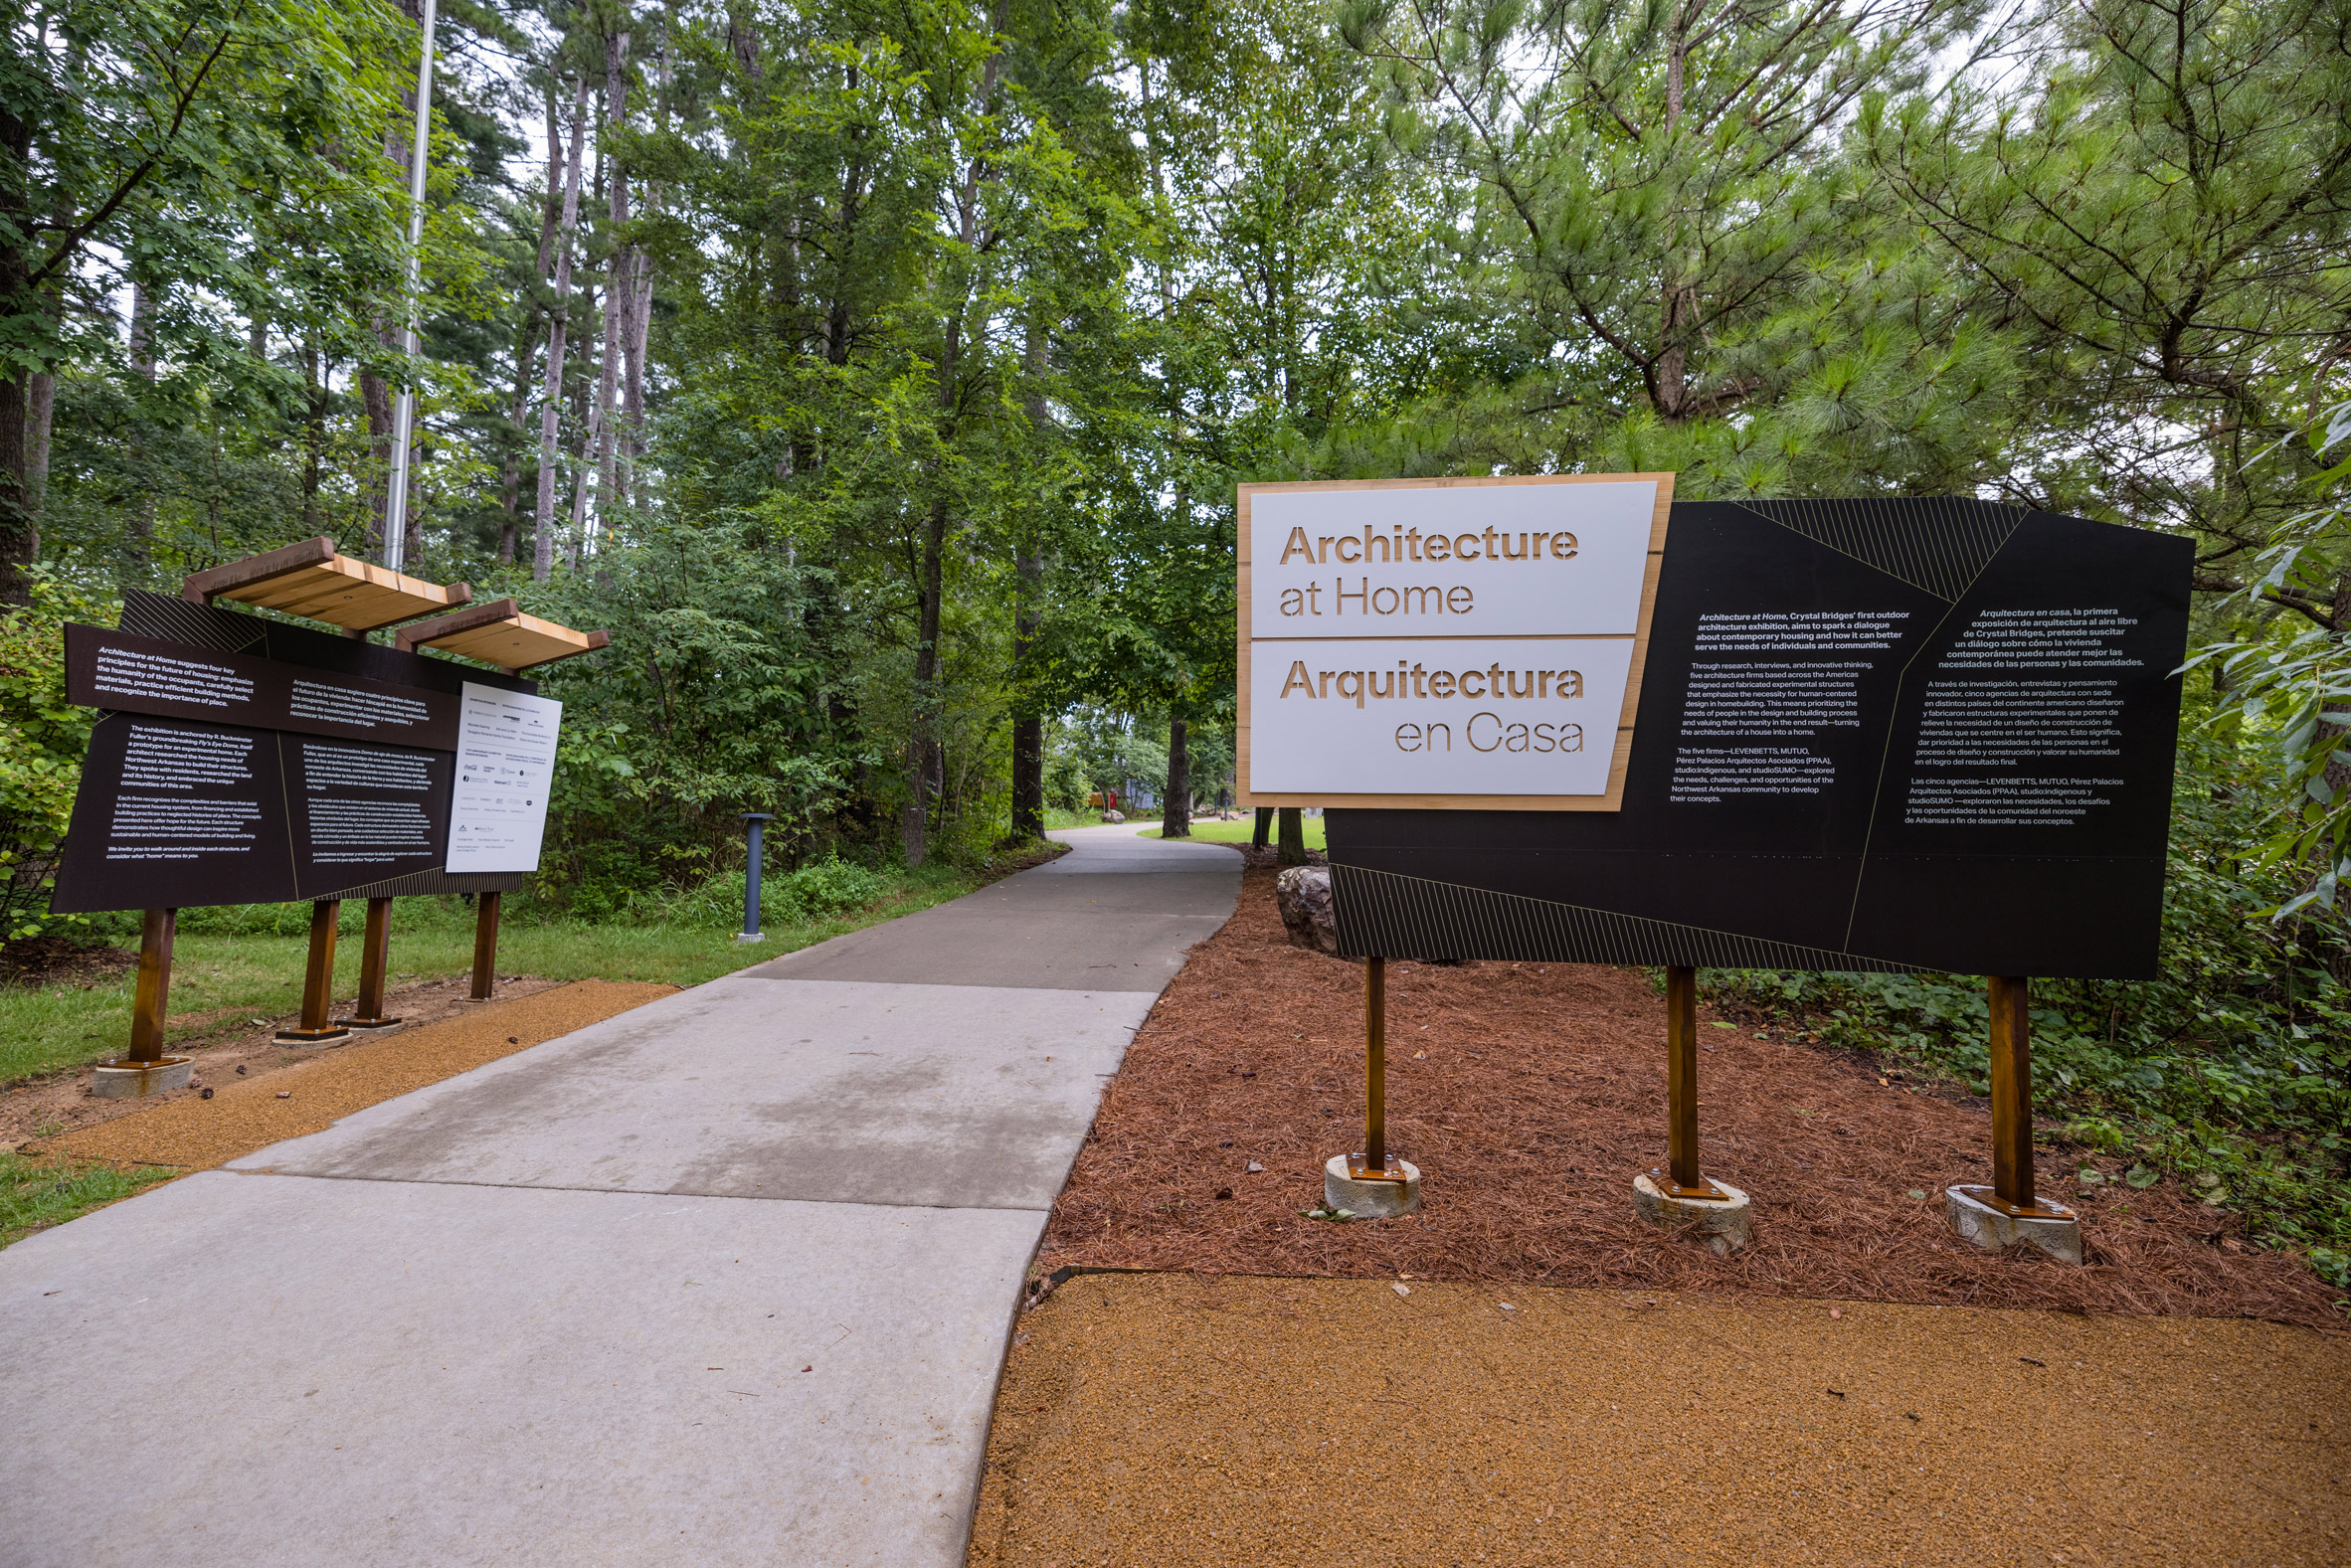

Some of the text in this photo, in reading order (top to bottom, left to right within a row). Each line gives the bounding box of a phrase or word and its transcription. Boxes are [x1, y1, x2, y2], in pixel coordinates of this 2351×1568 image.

[1280, 525, 1578, 565] Architecture
[1280, 577, 1474, 616] at Home
[1972, 619, 2019, 628] exposición
[1980, 610, 2035, 618] Arquitectura
[2083, 608, 2118, 616] primera
[2009, 629, 2046, 638] Bridges,
[2047, 628, 2087, 637] pretende
[98, 647, 146, 660] Architecture
[155, 655, 177, 664] Home
[209, 663, 223, 672] four
[224, 666, 235, 675] key
[1947, 650, 2015, 659] contemporánea
[97, 657, 136, 668] principles
[162, 665, 183, 674] future
[221, 676, 254, 685] emphasize
[111, 667, 146, 680] humanity
[206, 682, 234, 692] carefully
[165, 685, 194, 694] efficient
[194, 688, 221, 700] building
[1280, 660, 1583, 709] Arquitectura
[161, 692, 200, 703] importance
[1395, 712, 1583, 753] en Casa
